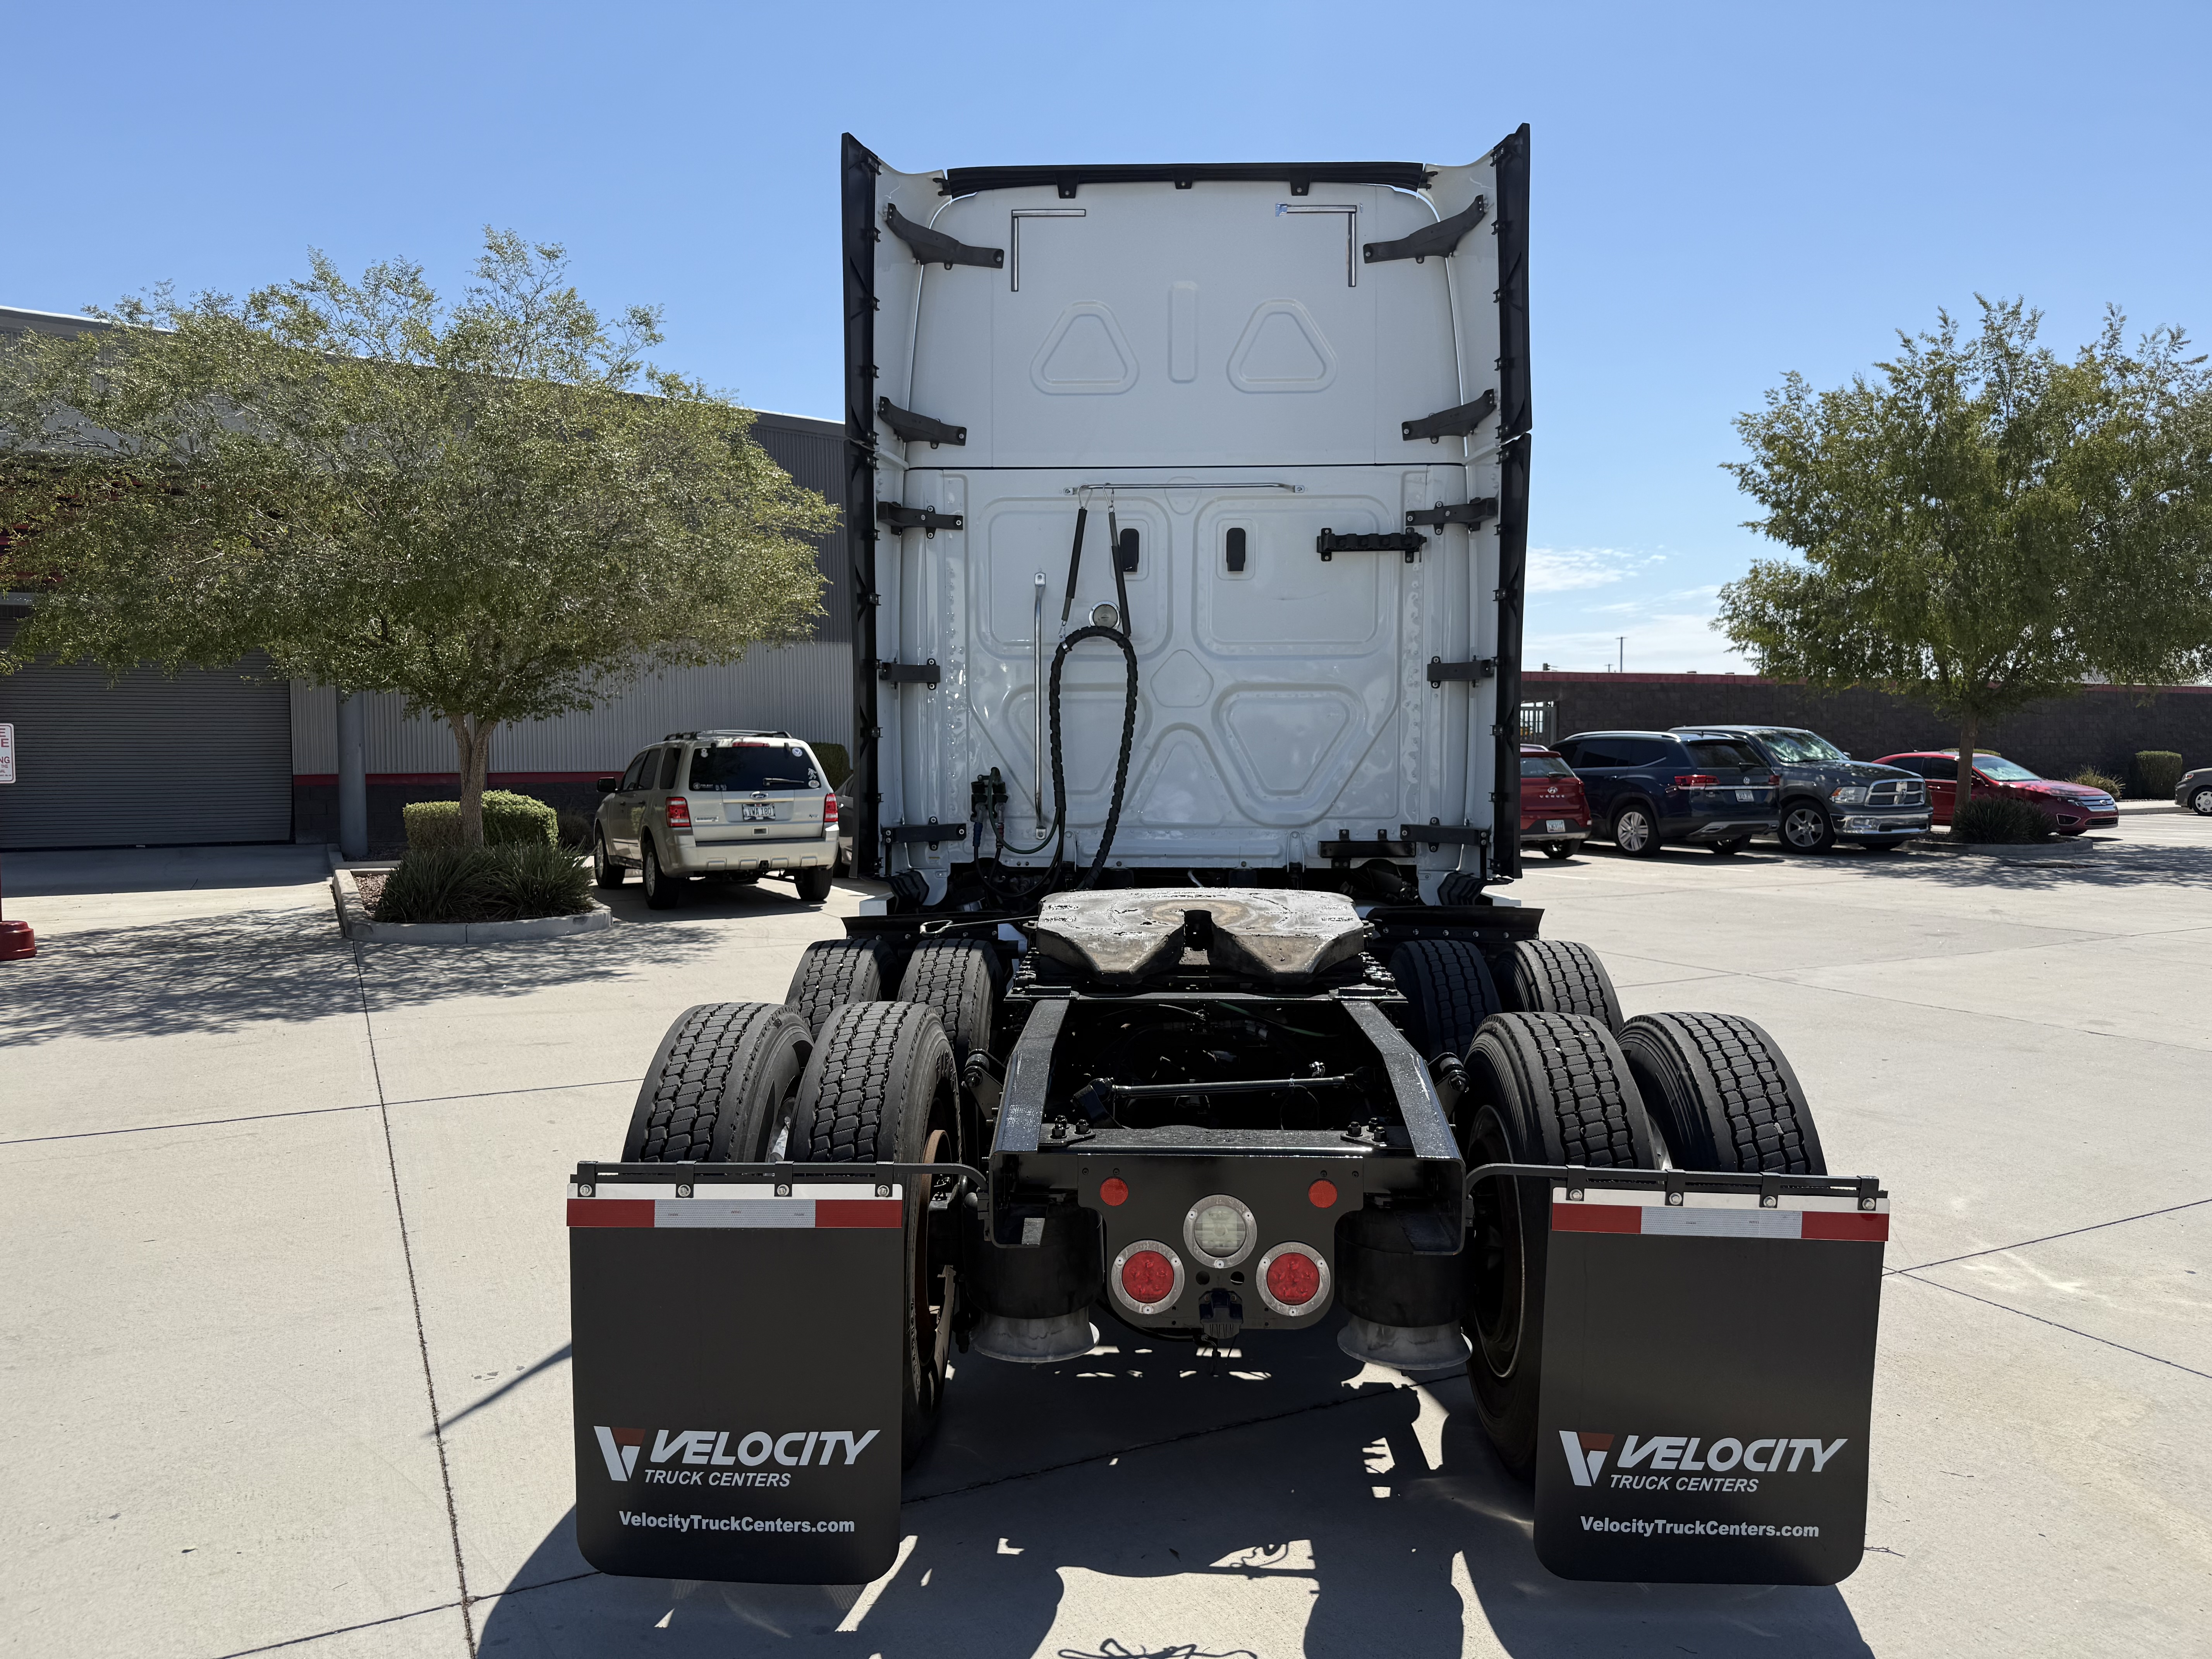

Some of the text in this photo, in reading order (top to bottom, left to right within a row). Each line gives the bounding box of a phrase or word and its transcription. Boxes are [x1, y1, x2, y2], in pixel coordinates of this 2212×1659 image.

[650, 1430, 880, 1466] VELOCITY
[1618, 1435, 1848, 1472] VELOCITY
[645, 1470, 791, 1487] TRUCK CENTERS
[1611, 1475, 1759, 1492] TRUCK CENTERS
[619, 1511, 855, 1532] VelocityTruckCenters.com
[1580, 1516, 1819, 1537] VelocityTruckCenters.com
